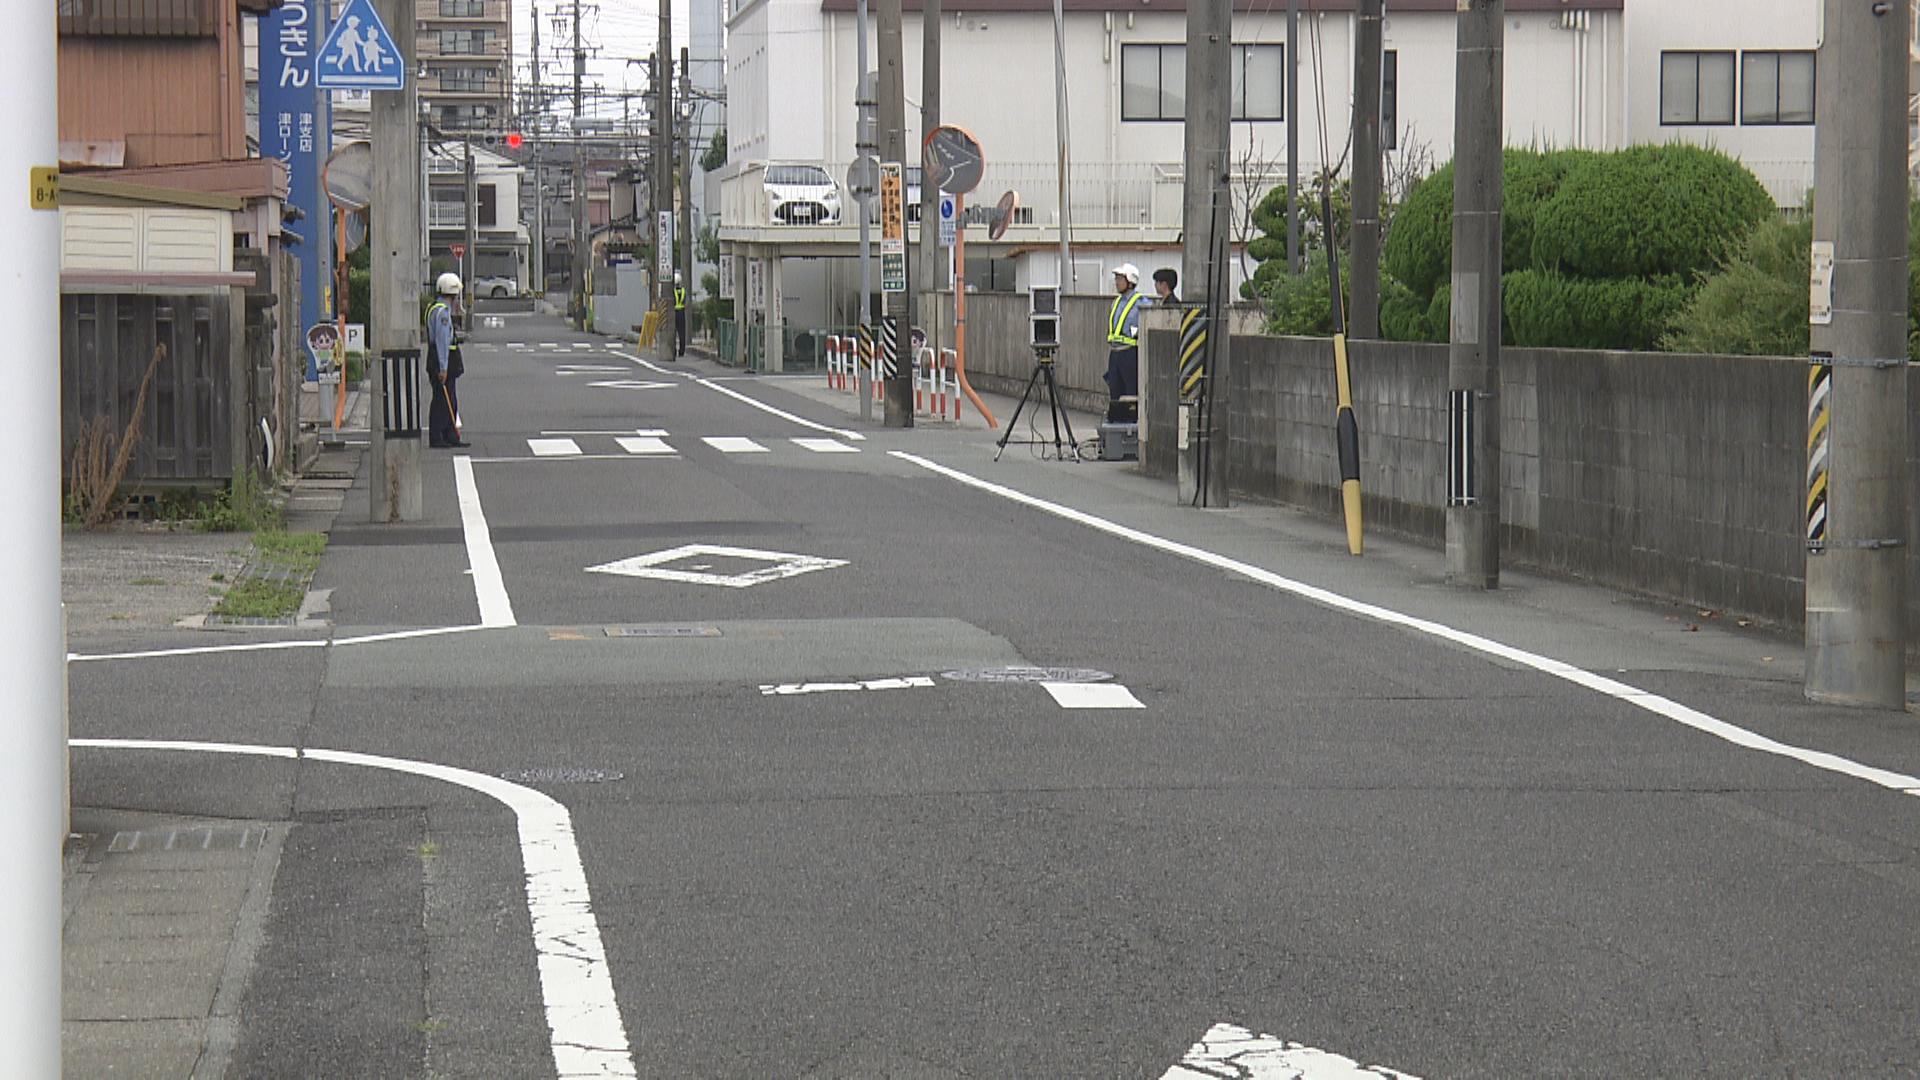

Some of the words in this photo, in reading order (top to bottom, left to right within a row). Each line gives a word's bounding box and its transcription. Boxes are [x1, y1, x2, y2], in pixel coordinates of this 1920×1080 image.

[298, 112, 313, 153] 津支店
[348, 328, 358, 343] P
